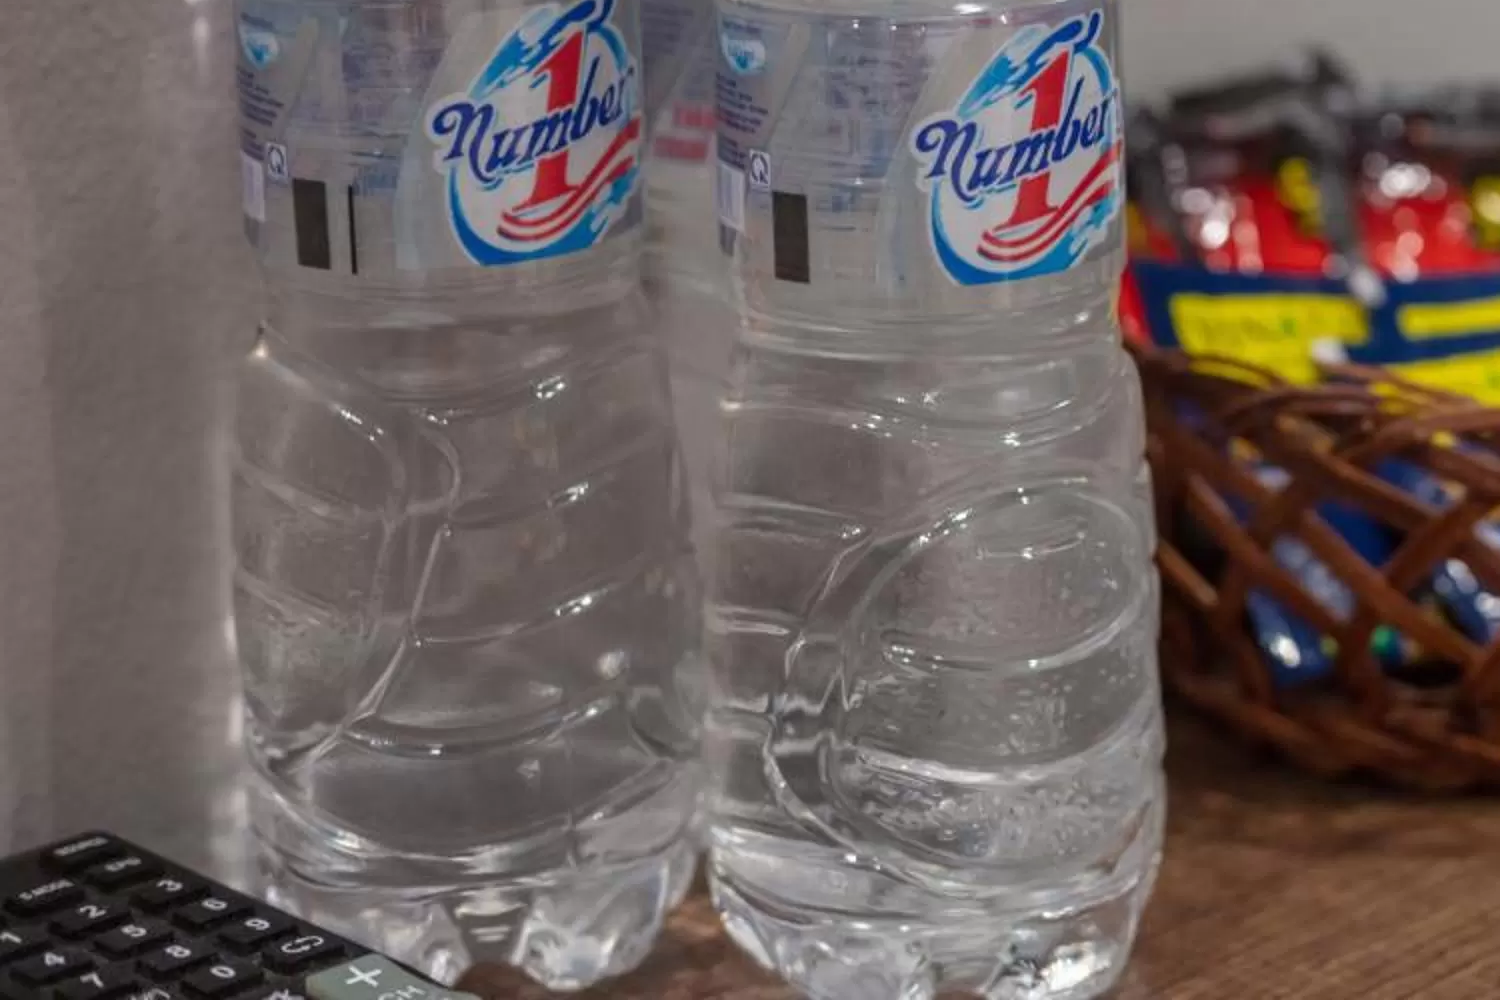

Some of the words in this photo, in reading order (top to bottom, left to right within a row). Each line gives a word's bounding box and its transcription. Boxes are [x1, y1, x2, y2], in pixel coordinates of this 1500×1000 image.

[157, 879, 183, 892] 3
[79, 904, 106, 919] 2
[121, 924, 148, 938] 5
[244, 917, 271, 931] 9
[165, 945, 192, 959] 8
[44, 952, 66, 967] 4
[210, 965, 236, 979] 0
